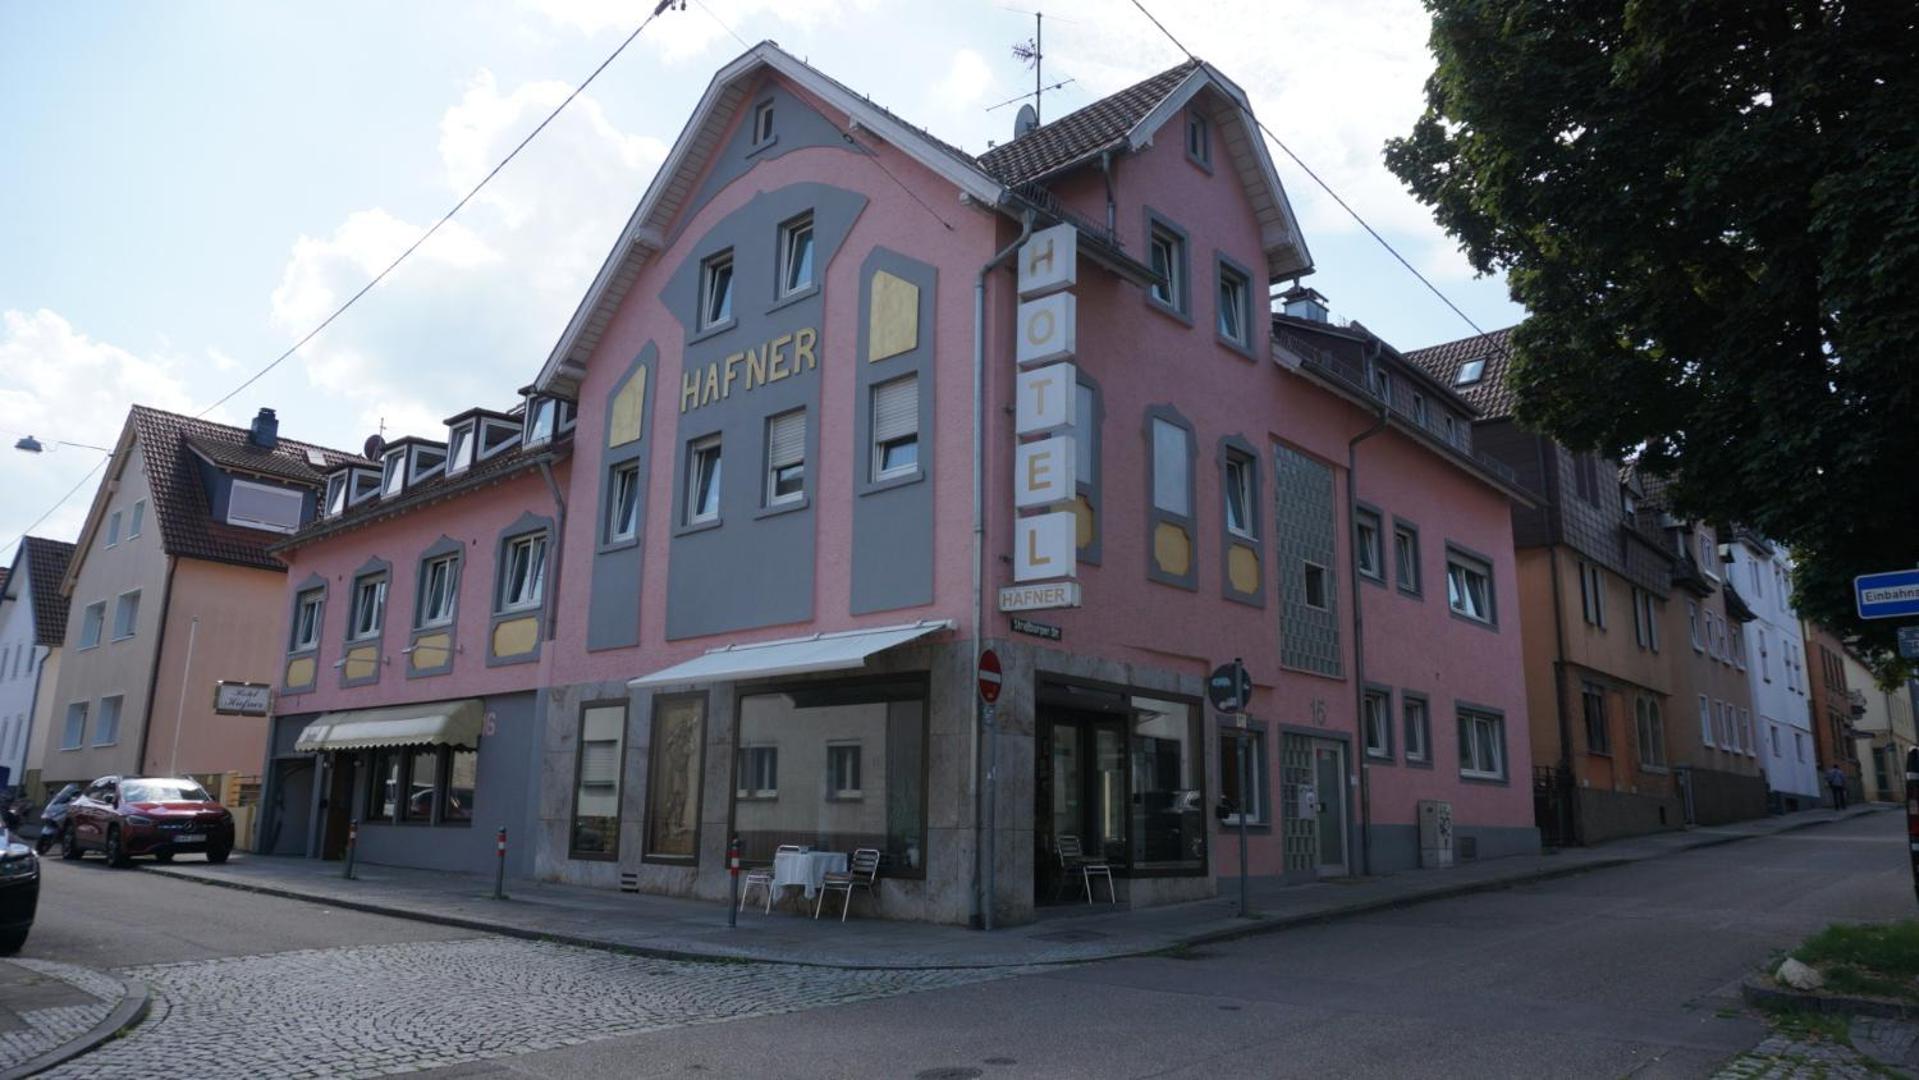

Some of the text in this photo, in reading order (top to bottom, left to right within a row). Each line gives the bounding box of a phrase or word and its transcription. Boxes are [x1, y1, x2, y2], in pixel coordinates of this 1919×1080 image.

[680, 326, 817, 413] HAFNER
[1027, 238, 1056, 567] HOTEL
[1001, 587, 1066, 607] HAFNER
